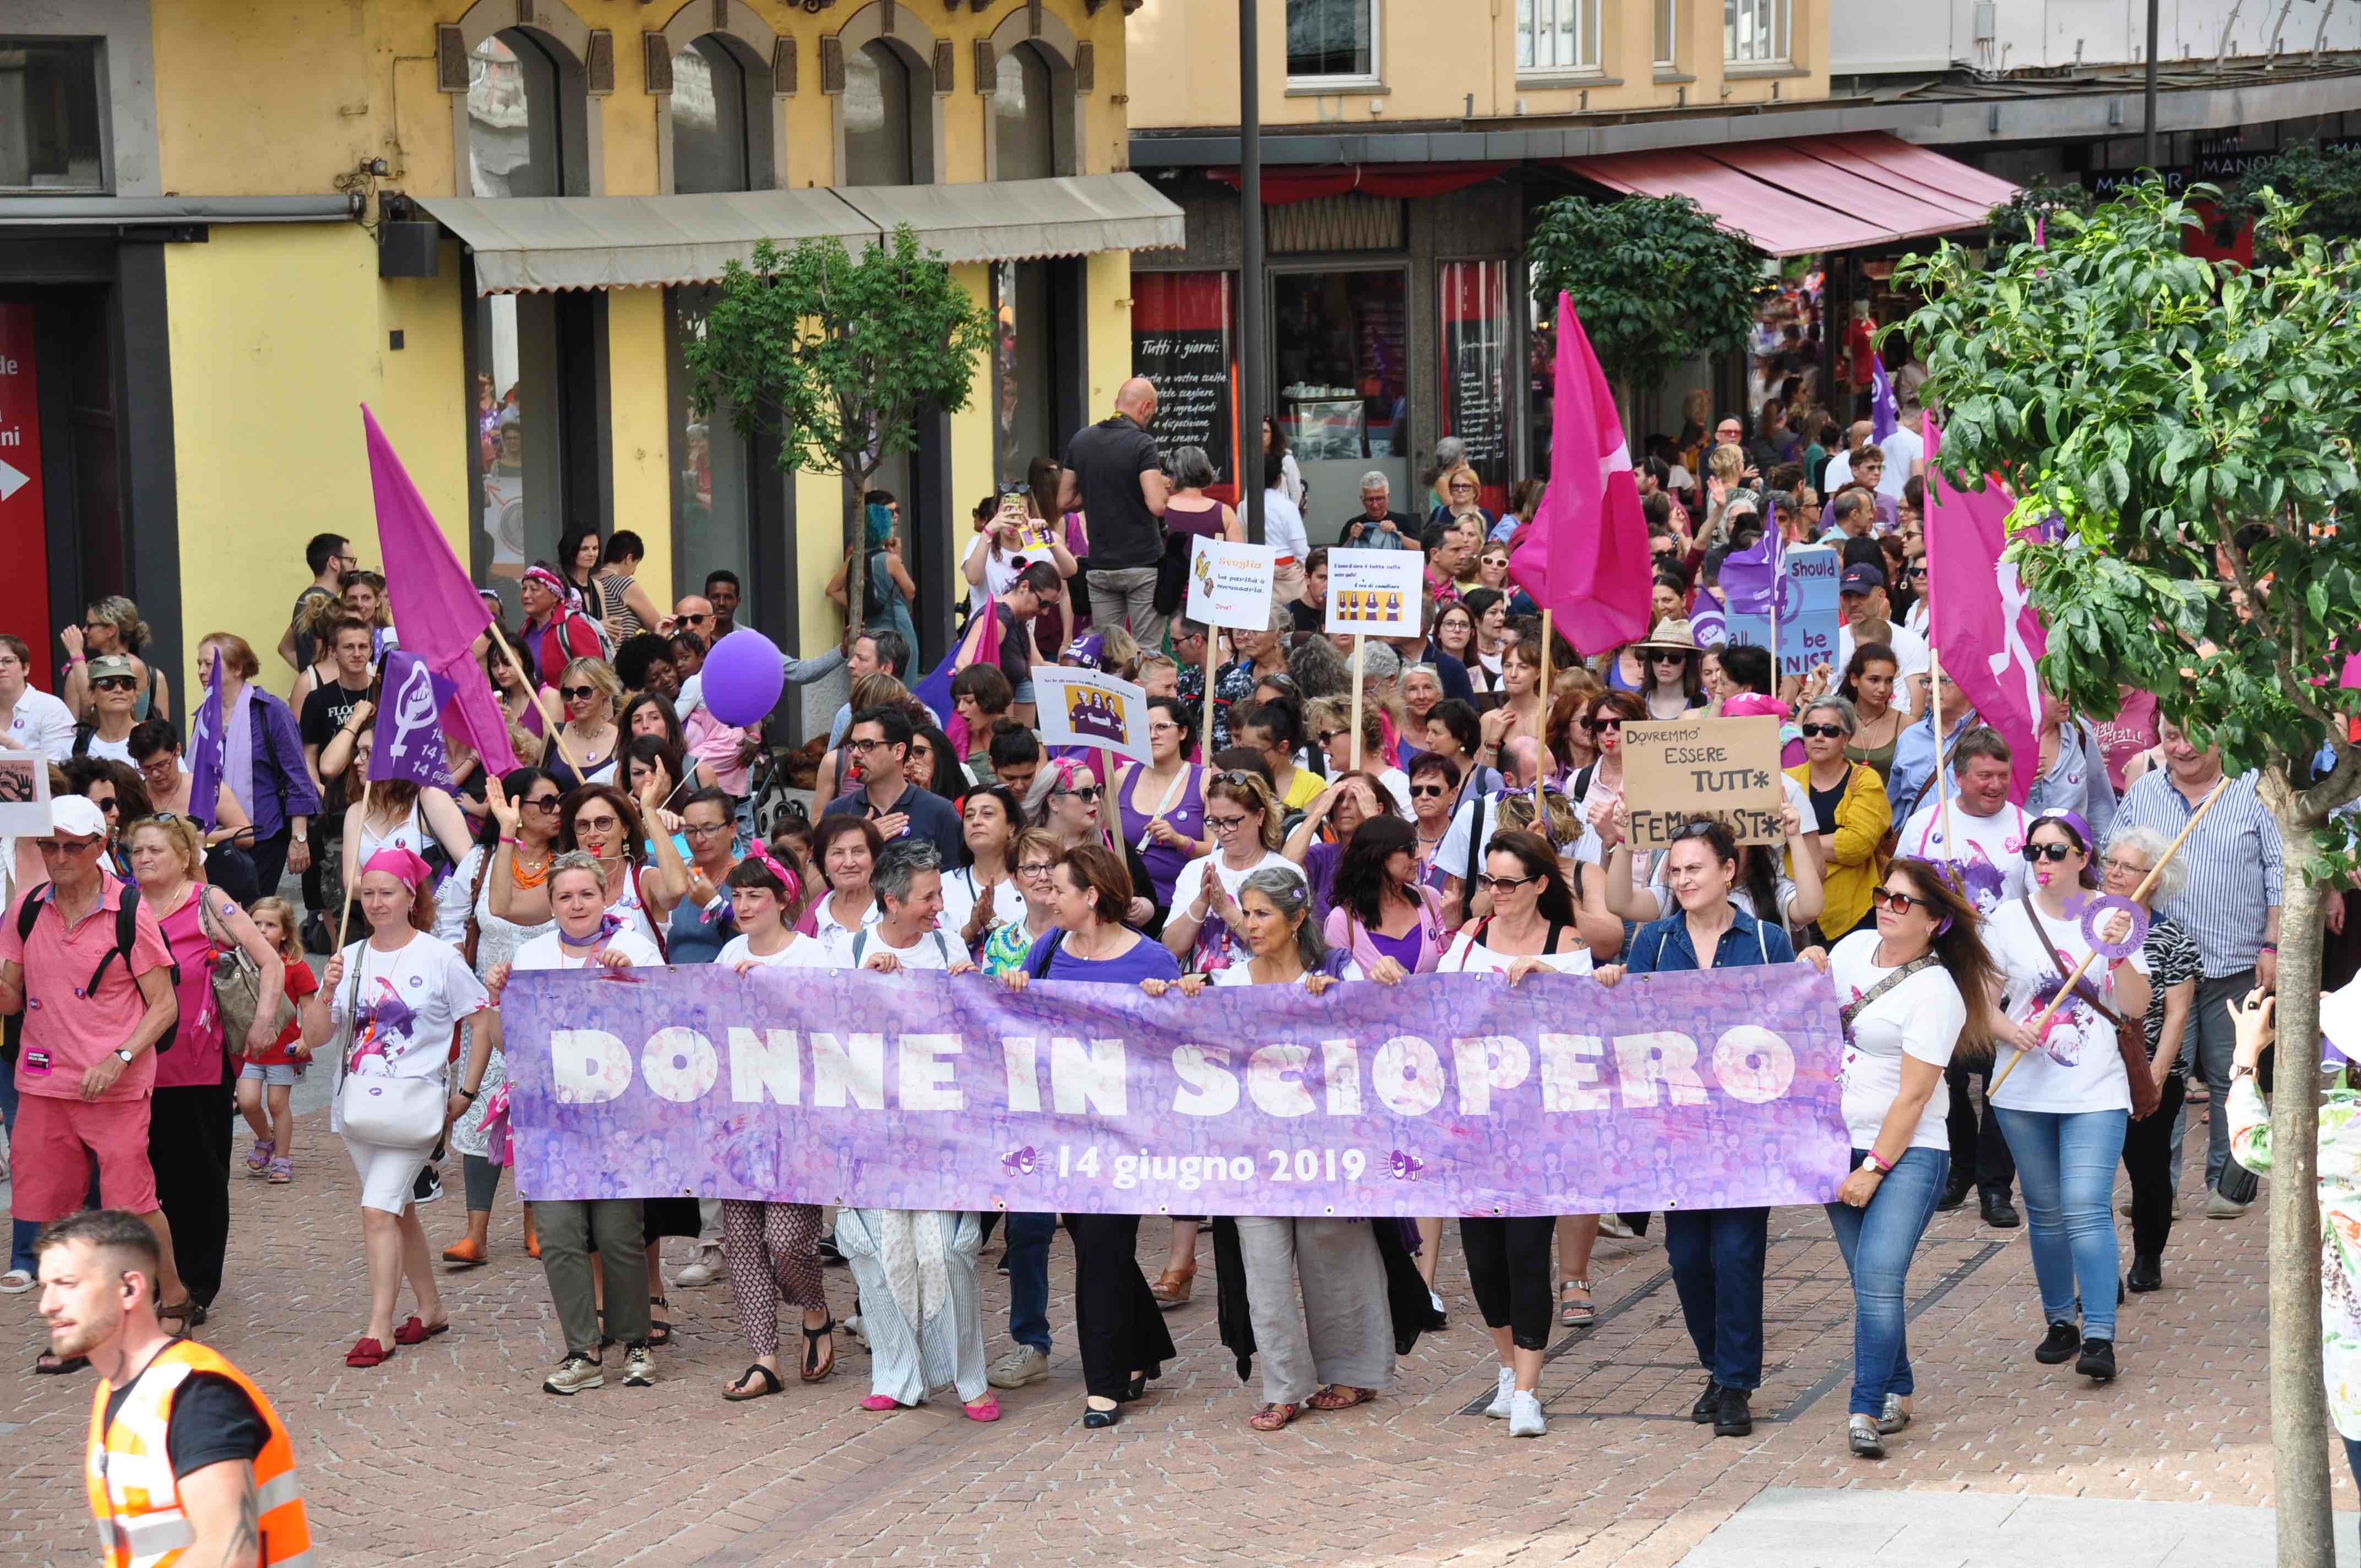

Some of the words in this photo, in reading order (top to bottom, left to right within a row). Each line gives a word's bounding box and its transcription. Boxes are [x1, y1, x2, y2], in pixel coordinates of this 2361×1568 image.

[2096, 172, 2182, 193] MANR
[1142, 339, 1172, 355] Tutti
[1174, 340, 1181, 353] i
[1180, 339, 1220, 359] giorni:
[1173, 372, 1199, 383] vostra
[1178, 387, 1215, 401] scegliere
[1173, 402, 1218, 416] ingredienti
[1162, 418, 1211, 432] disposizione
[1171, 434, 1200, 442] creare
[1792, 557, 1835, 577] should
[1803, 628, 1827, 648] be
[1626, 727, 1700, 745] DOVREMMO
[421, 744, 438, 759] 14
[1665, 747, 1727, 764] ESSERE
[412, 760, 429, 776] 14
[551, 1026, 964, 1111] DONNE
[1002, 1037, 1128, 1116] IN
[1172, 1025, 1796, 1118] SCIOPERO
[1059, 1146, 1099, 1178] 14
[1114, 1148, 1255, 1190] giugno
[1269, 1148, 1366, 1182] 2019
